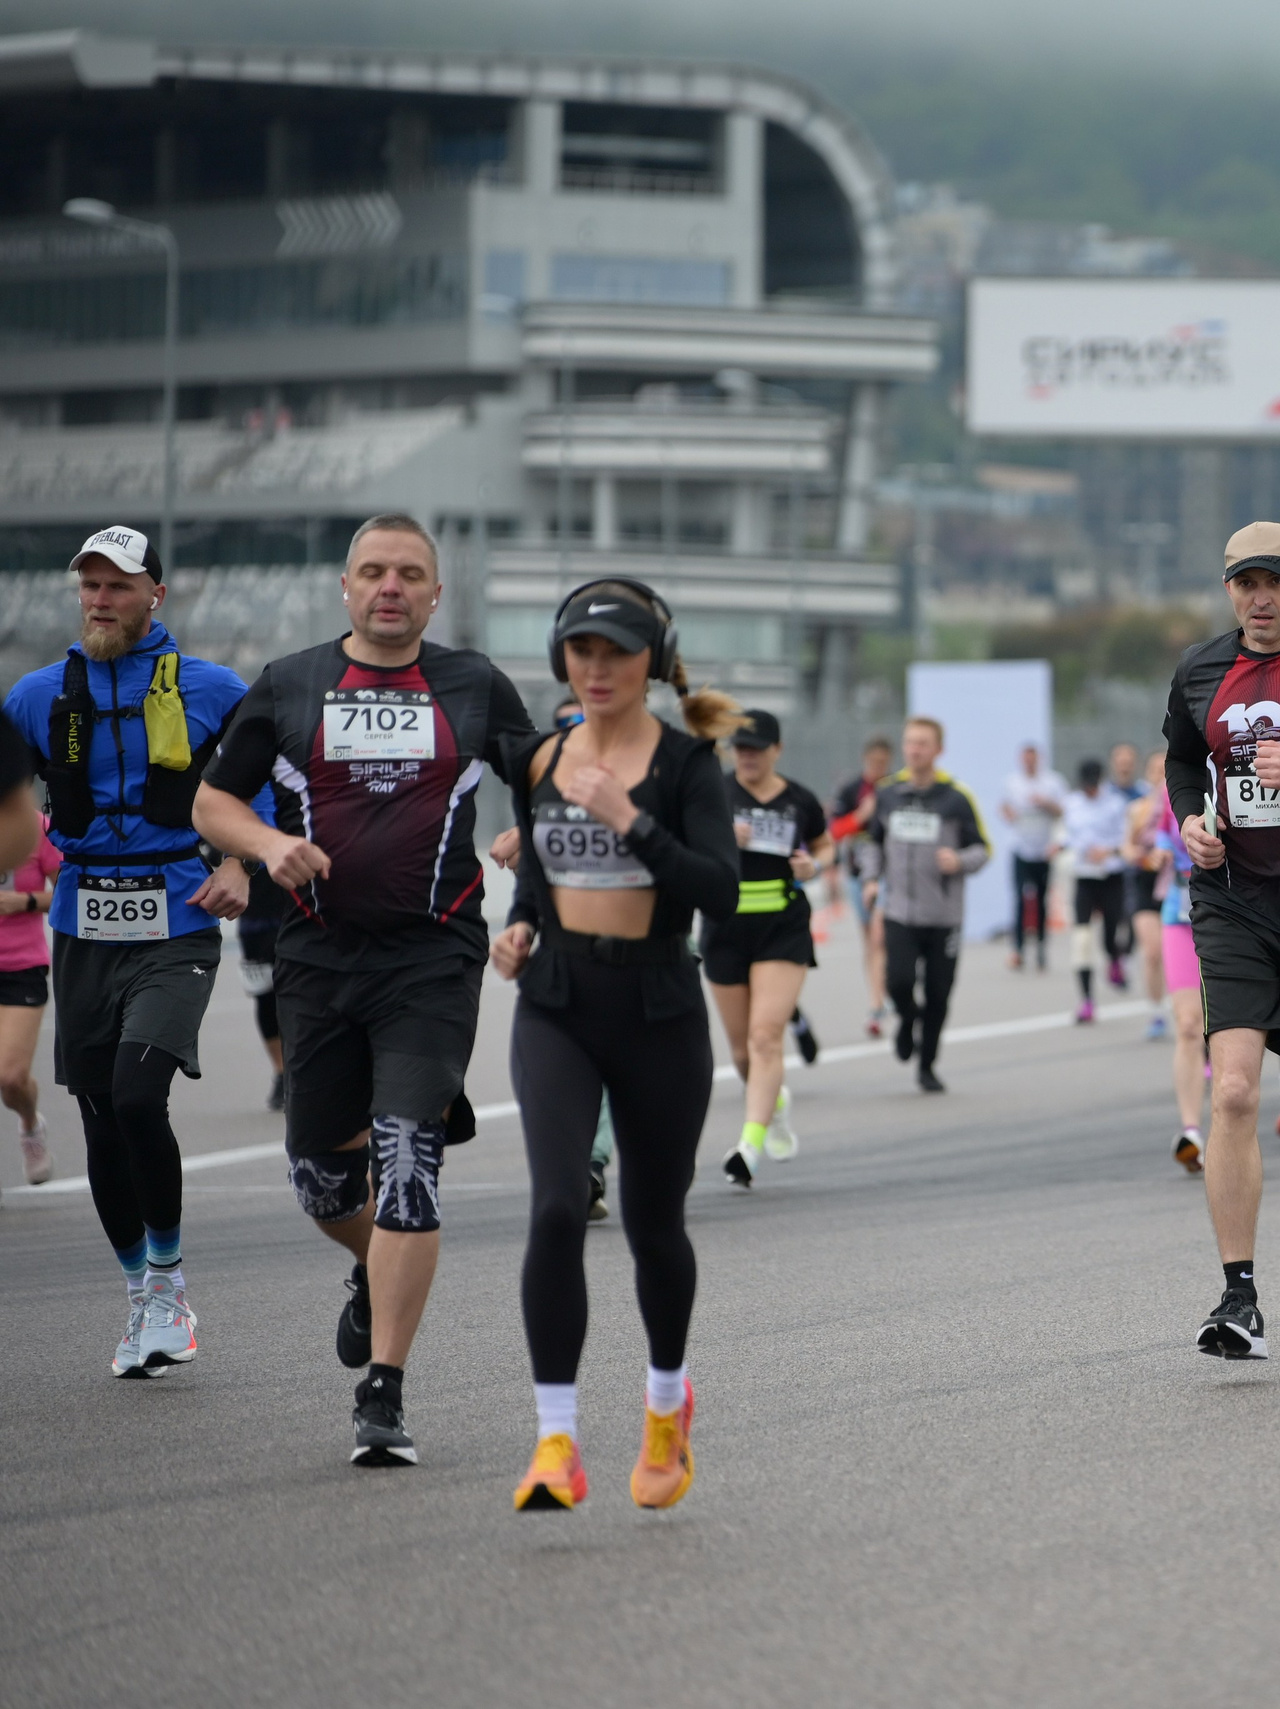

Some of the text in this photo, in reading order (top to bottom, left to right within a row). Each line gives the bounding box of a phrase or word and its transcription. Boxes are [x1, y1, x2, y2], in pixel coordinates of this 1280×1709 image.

[89, 531, 133, 550] EVERLAST
[340, 708, 419, 732] 7102
[364, 733, 394, 741] СЕРГЕЙ
[348, 761, 420, 775] SIRIUS
[364, 781, 397, 793] RAY
[86, 898, 158, 922] 8269
